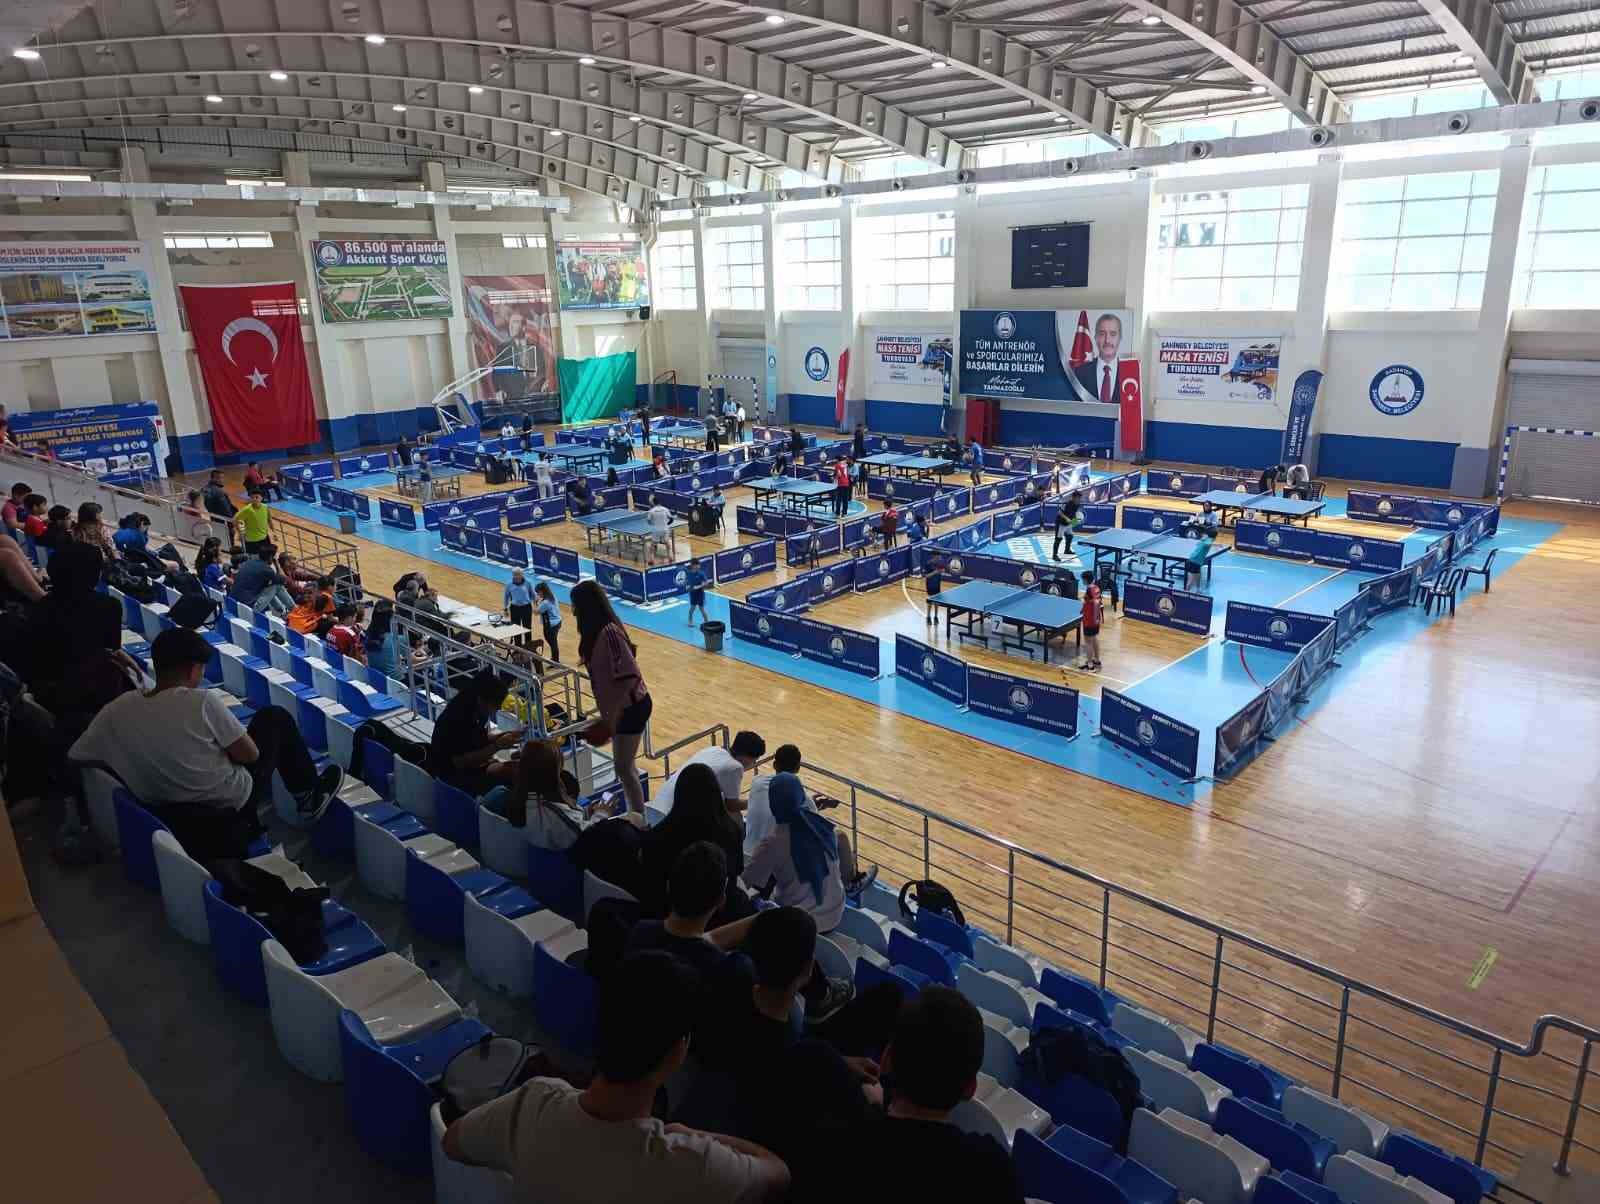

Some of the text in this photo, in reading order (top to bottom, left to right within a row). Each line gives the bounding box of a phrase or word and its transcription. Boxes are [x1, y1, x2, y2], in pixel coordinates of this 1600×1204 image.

[344, 241, 388, 254] 86.500
[346, 253, 448, 266] Akkent Spor Köyü
[975, 338, 1036, 351] TÜM ANTRENÖR
[976, 351, 1045, 362] SPORCULARIMIZA
[1161, 350, 1228, 364] MASA TENİSİ
[966, 361, 1045, 373] BAŞARILAR DİLERİM
[1170, 365, 1217, 374] TURNUVASI
